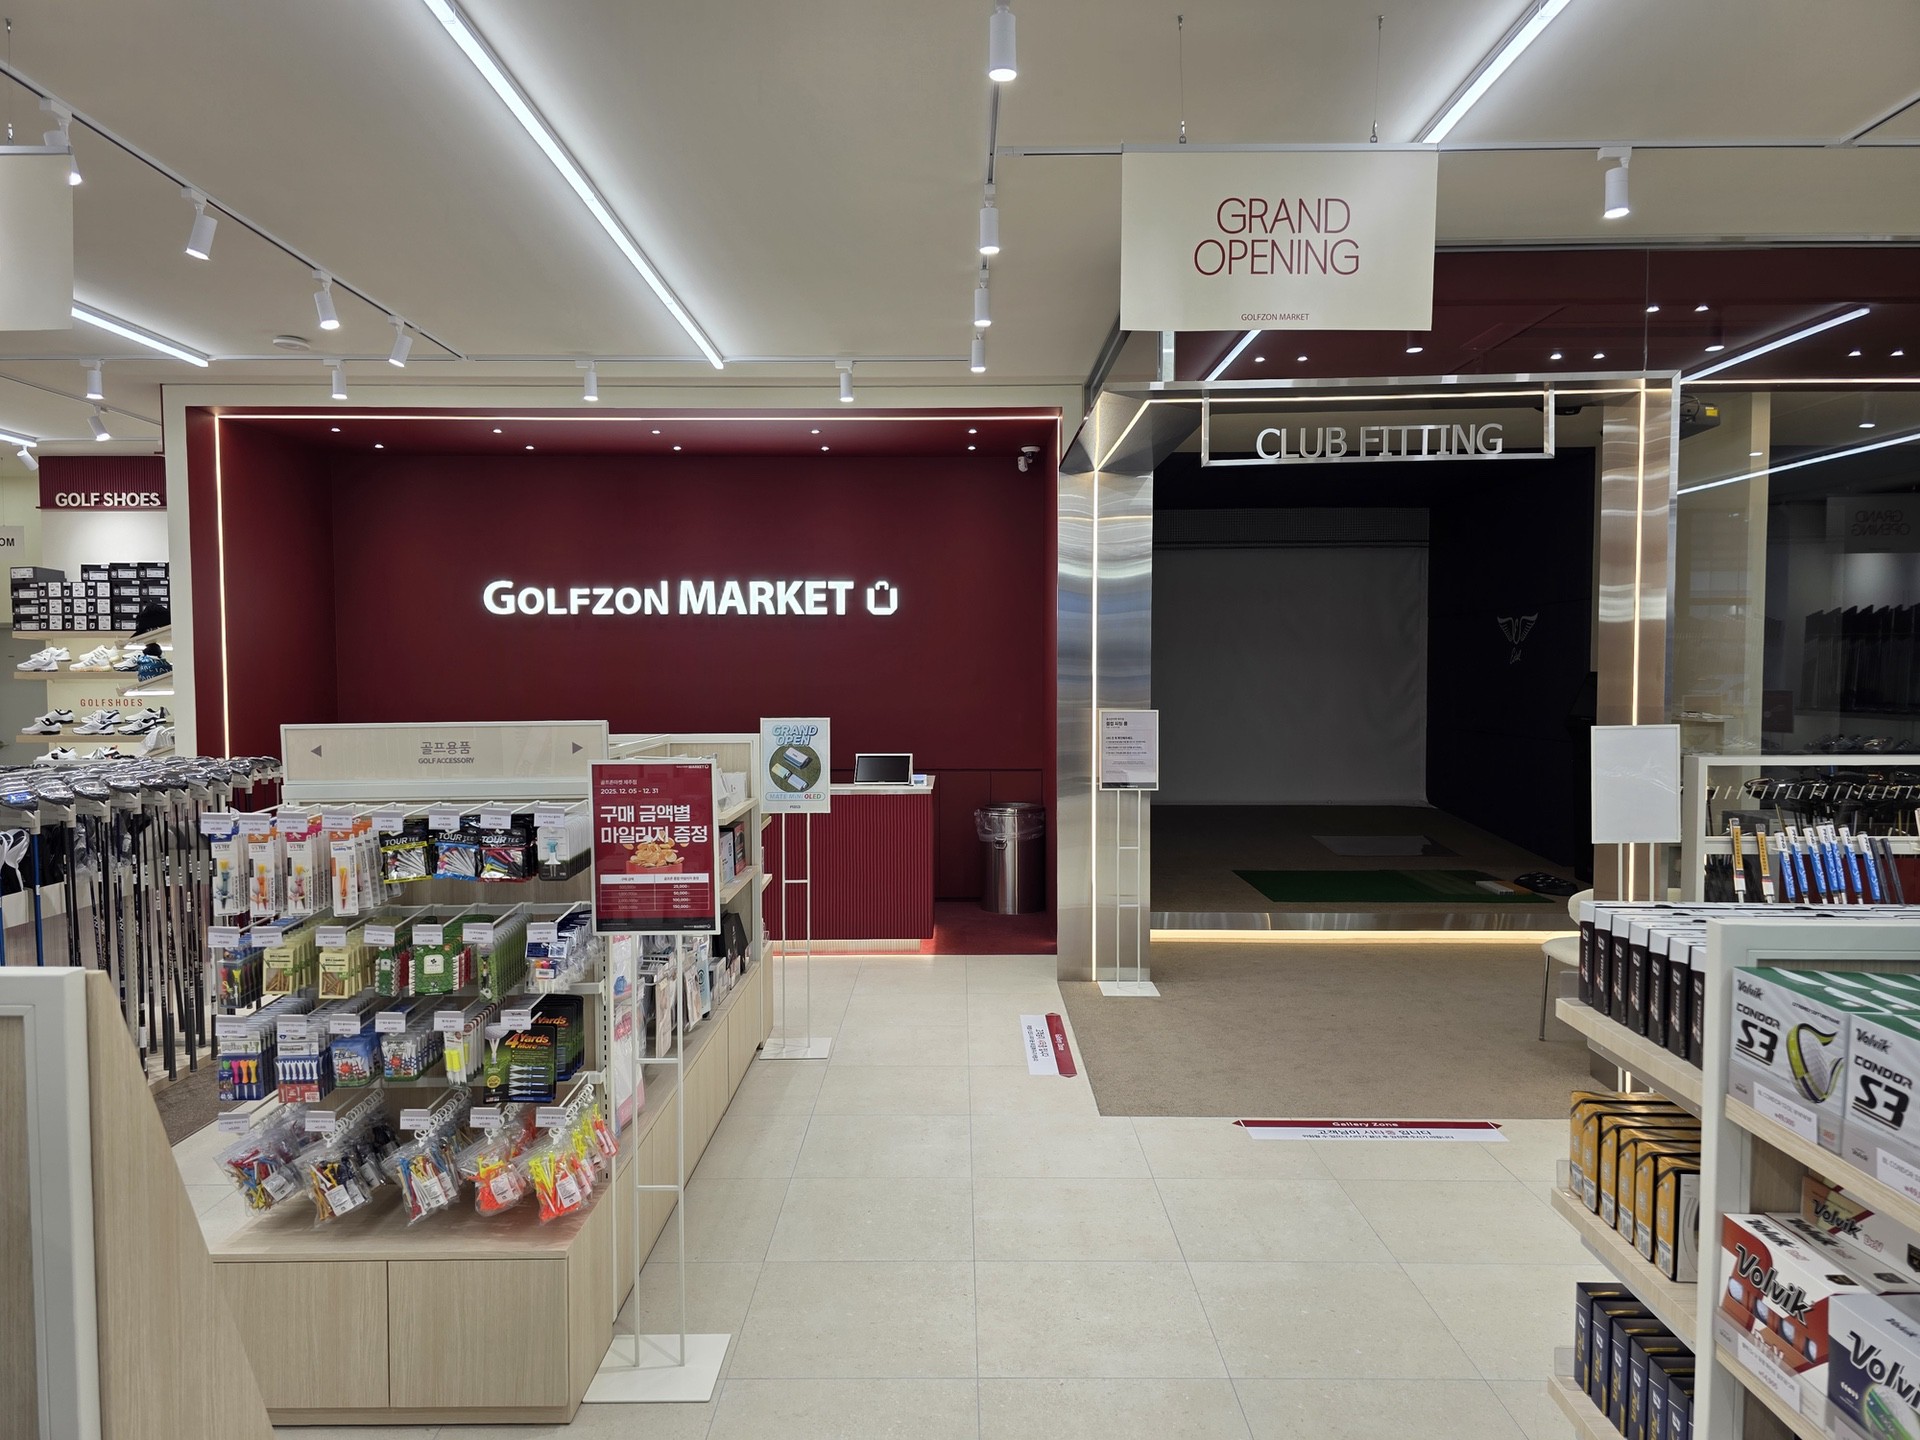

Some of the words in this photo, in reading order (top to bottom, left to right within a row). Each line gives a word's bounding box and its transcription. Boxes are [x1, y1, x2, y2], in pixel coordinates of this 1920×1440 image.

[1216, 197, 1351, 235] GRAND
[1193, 238, 1360, 276] OPENING
[1241, 312, 1278, 322] GOLFZON
[1279, 312, 1310, 321] MARKET
[1256, 426, 1348, 460] CLUB
[1359, 423, 1503, 458] FITTING
[55, 492, 100, 507] GOLF
[103, 492, 161, 507] SHOES
[483, 579, 670, 616] GOLFZON
[678, 579, 855, 616] MARKET
[80, 698, 143, 707] GOLFSHOES
[771, 724, 818, 737] GRAND
[420, 741, 471, 755] 골프용품
[776, 735, 812, 747] OPEN
[600, 805, 635, 823] 구매
[639, 804, 691, 823] 금액별
[385, 837, 408, 846] TOUR
[438, 832, 463, 842] TOUR
[481, 835, 506, 844] TOUR
[601, 826, 670, 844] 마일리지
[673, 825, 708, 843] 증정
[1737, 978, 1765, 1001] Volvik
[537, 1016, 567, 1025] Yards
[1735, 1003, 1781, 1030] CONDOR
[504, 1033, 519, 1048] 4
[519, 1033, 550, 1043] Yards
[1737, 1019, 1779, 1065] S3
[1856, 1027, 1893, 1054] Volvik
[1854, 1055, 1913, 1089] CONDOR
[1854, 1074, 1910, 1131] S3
[1813, 1199, 1862, 1240] Volvik
[1735, 1244, 1813, 1325] Volvik
